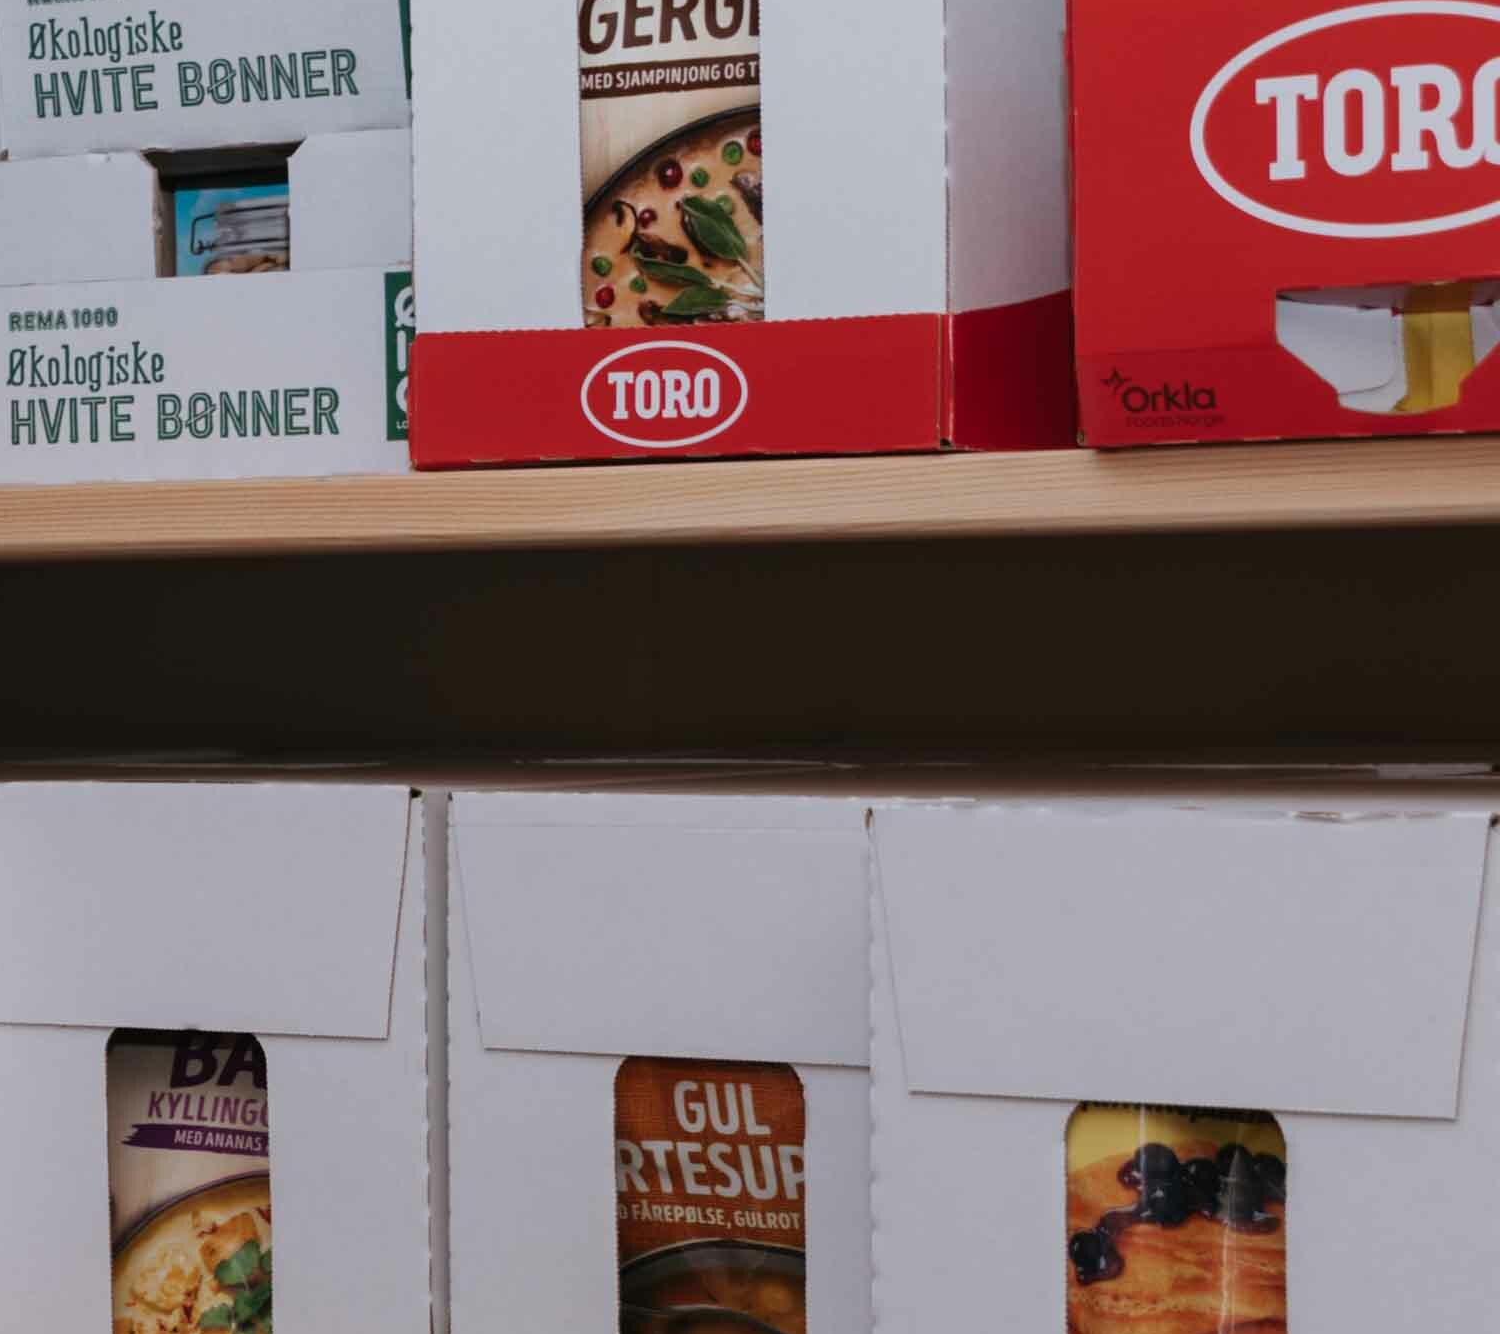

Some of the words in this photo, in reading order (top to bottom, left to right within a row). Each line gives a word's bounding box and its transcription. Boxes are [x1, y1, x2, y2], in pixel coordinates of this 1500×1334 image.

[28, 10, 183, 63] Økologiske
[34, 65, 159, 119] HVITE
[177, 48, 360, 108] BØNNER
[581, 73, 613, 90] MED
[616, 63, 722, 89] SJAMPINJONG
[724, 62, 746, 80] OG
[9, 310, 68, 332] REMA
[72, 307, 118, 329] 1000
[6, 340, 165, 392] Økologiske
[10, 395, 135, 445] HVITE
[157, 387, 340, 440] BØNNER
[607, 367, 721, 420] TORO
[1122, 382, 1217, 414] Orkla
[673, 1079, 772, 1136] GUL
[173, 1129, 203, 1145] MED
[205, 1133, 262, 1152] ANANAS
[631, 1198, 732, 1230] FÅREPØLSE,
[733, 1210, 801, 1230] GULROT
